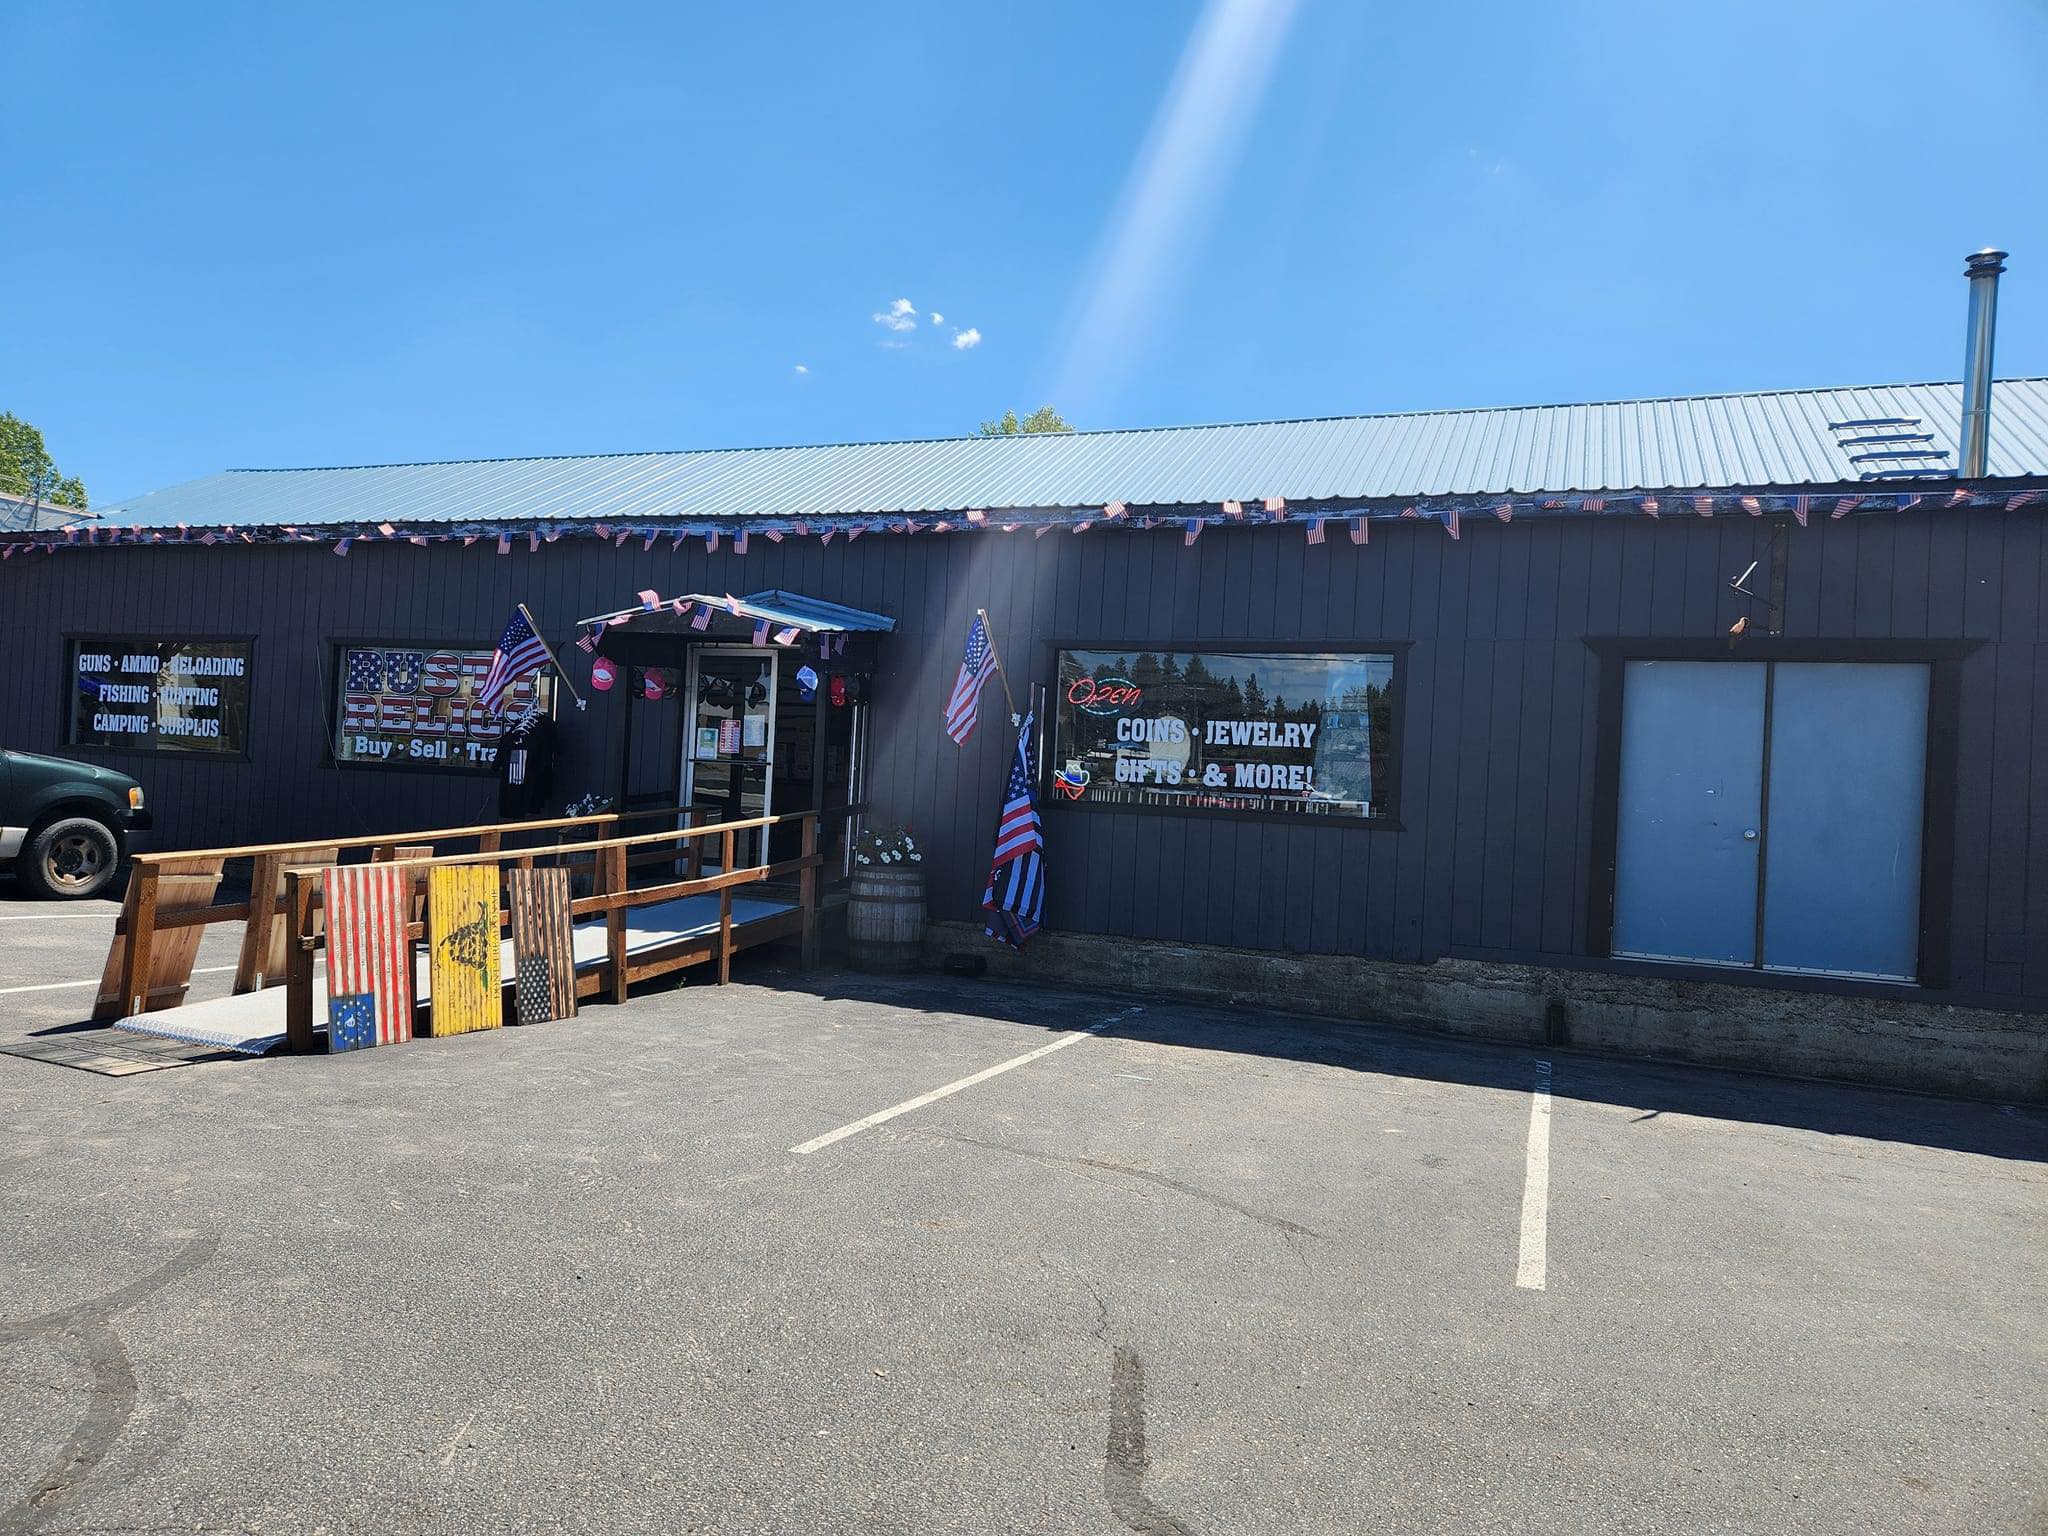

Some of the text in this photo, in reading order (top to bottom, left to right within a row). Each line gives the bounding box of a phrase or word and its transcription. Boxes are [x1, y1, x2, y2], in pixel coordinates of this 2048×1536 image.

[79, 654, 245, 677] GUNS AMMO RELOADING
[99, 684, 219, 707] FISHING HUNTING
[93, 713, 220, 738] CAMPING SURPLUS
[1117, 717, 1316, 748] COINS JEWELRY
[355, 736, 393, 759] Buy
[410, 738, 447, 759] Sell
[1115, 758, 1313, 791] GIFTS & MORE!
